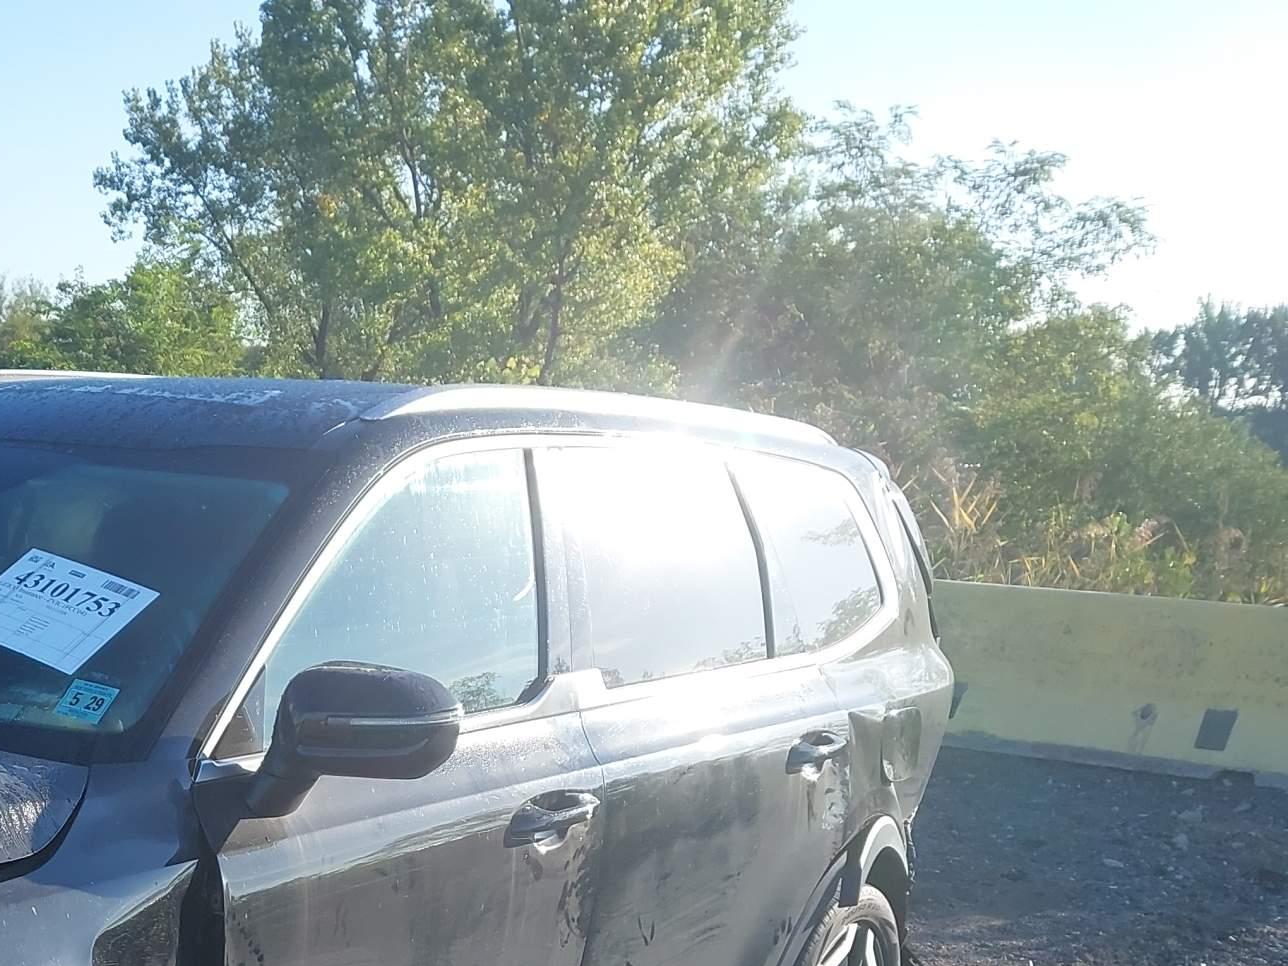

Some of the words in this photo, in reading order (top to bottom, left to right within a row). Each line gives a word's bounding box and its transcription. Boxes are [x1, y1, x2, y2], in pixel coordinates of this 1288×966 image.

[15, 571, 121, 617] 43101753
[70, 692, 81, 706] 5
[83, 696, 105, 712] 29
